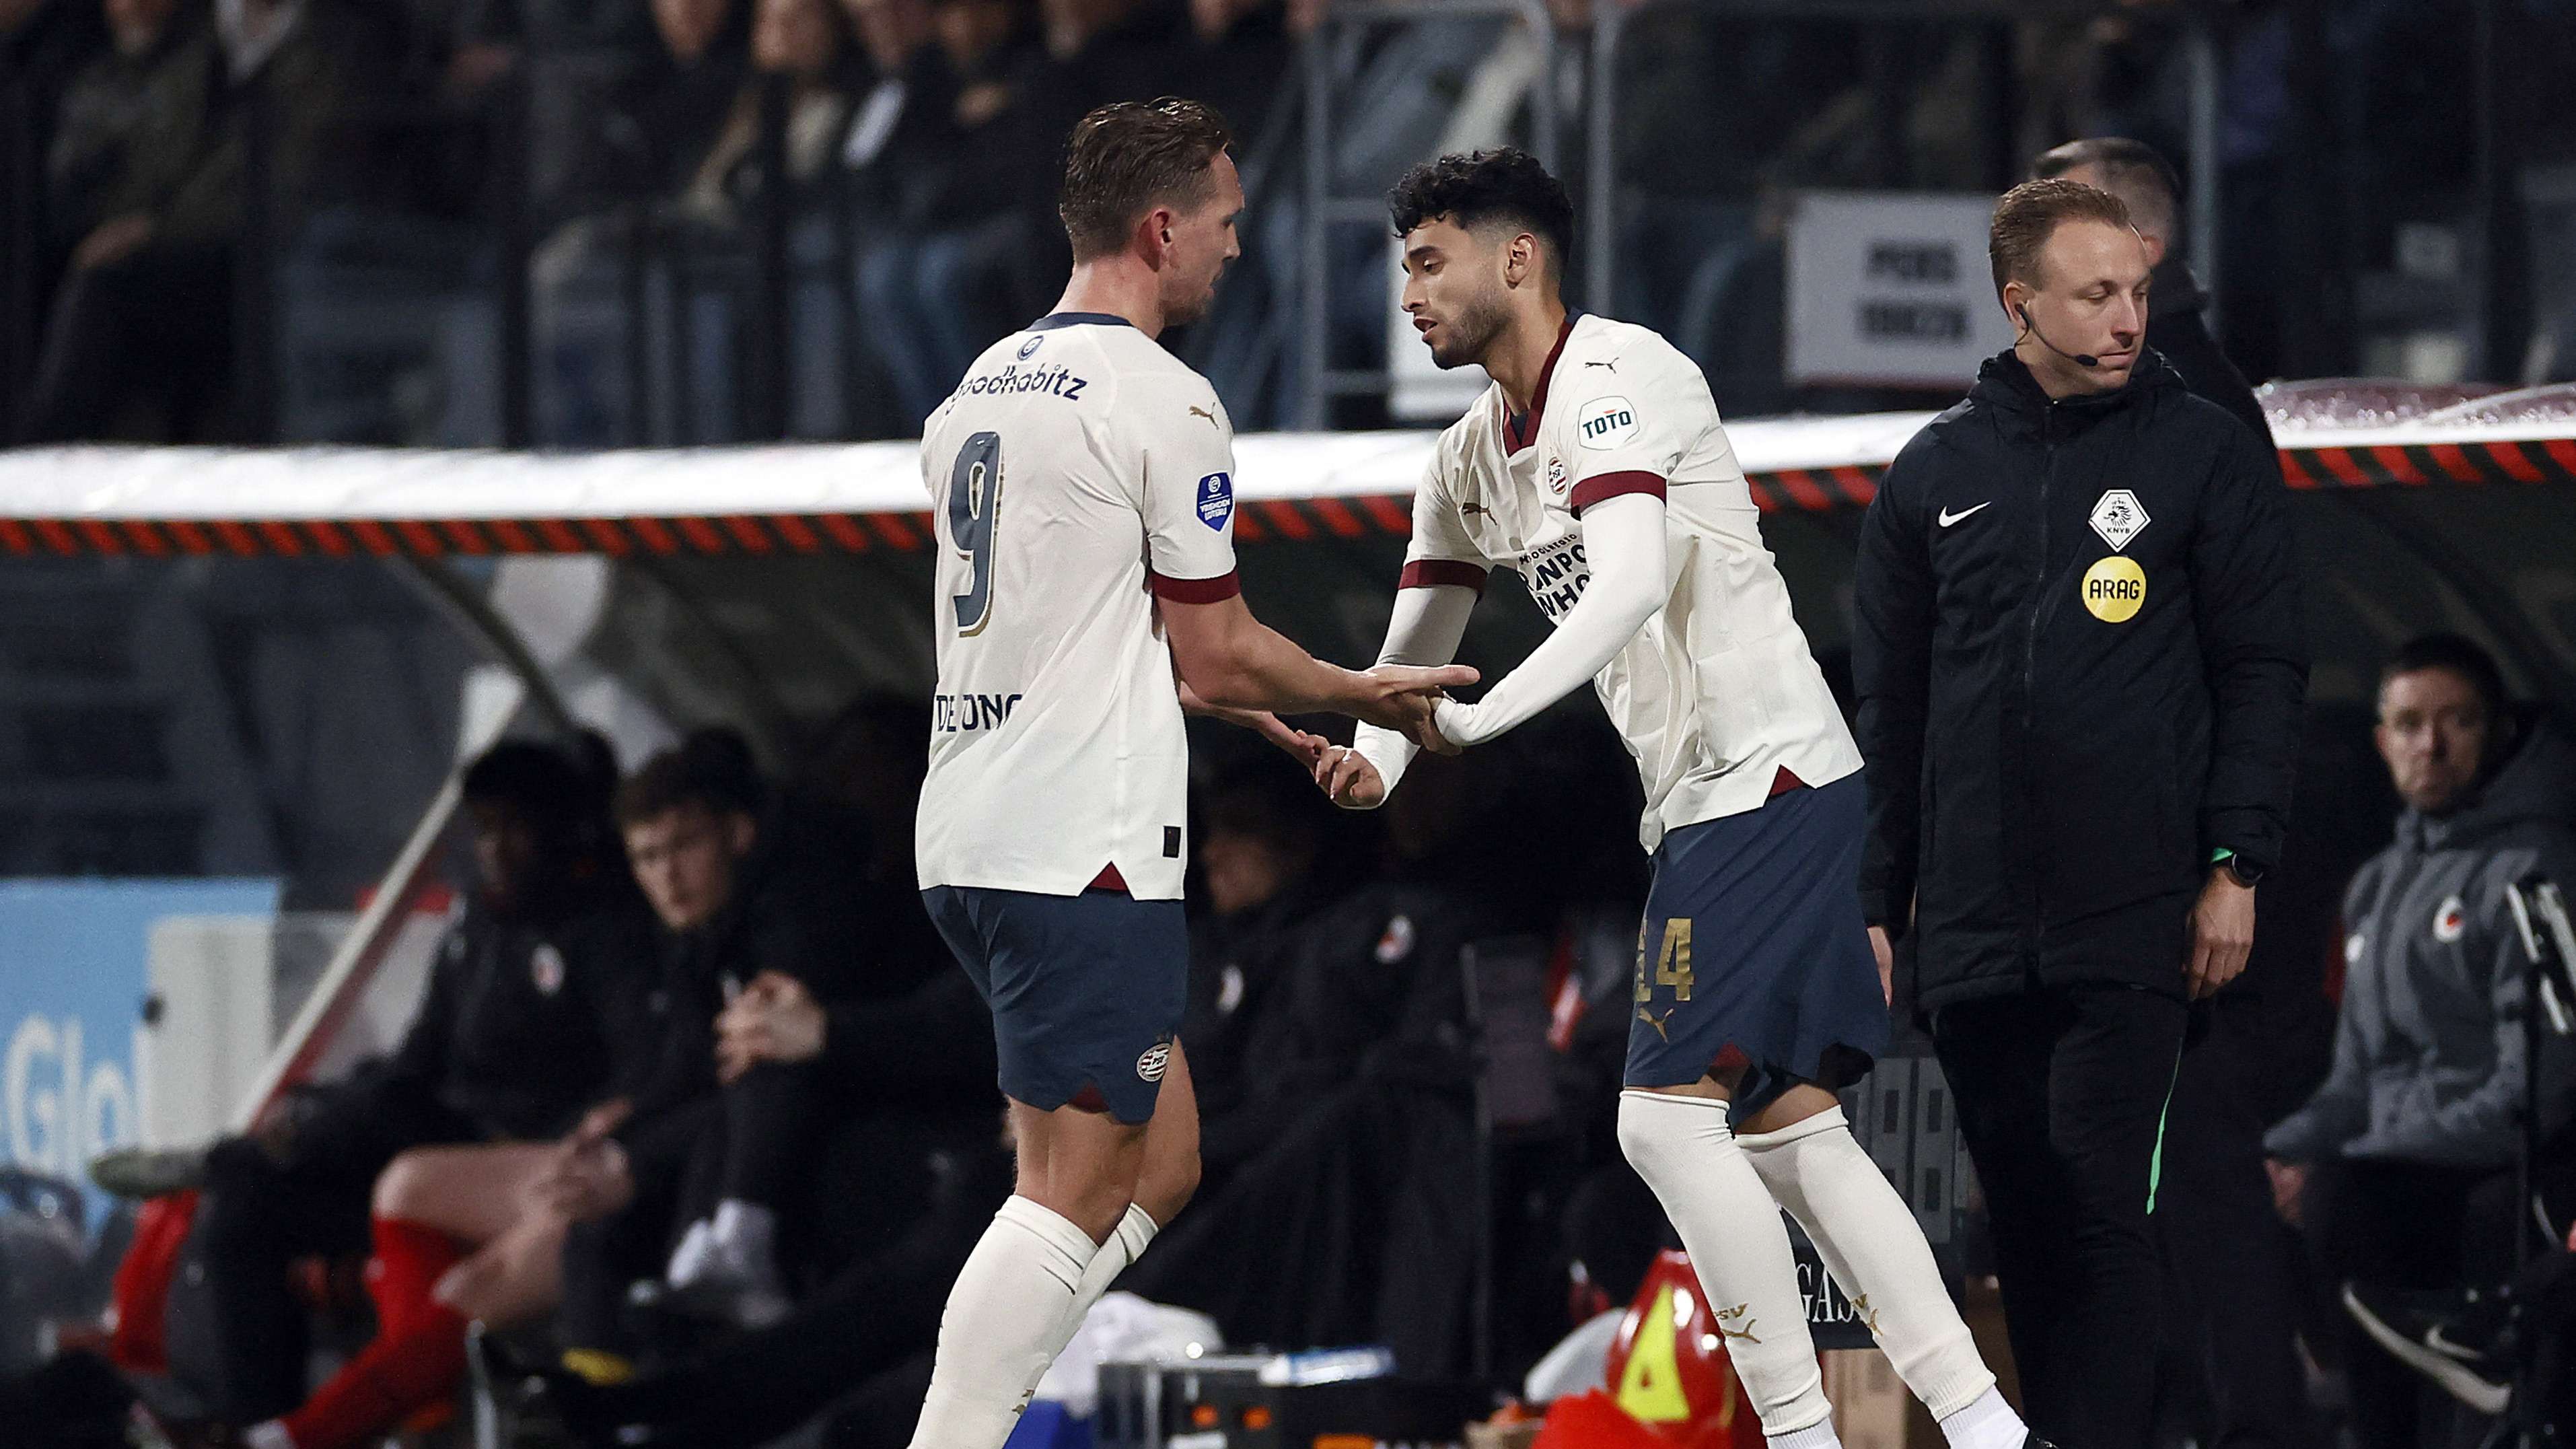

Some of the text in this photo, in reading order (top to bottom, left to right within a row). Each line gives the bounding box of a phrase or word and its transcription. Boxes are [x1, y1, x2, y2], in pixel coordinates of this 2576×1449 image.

[1582, 410, 1632, 439] TOTO
[948, 431, 1005, 637] 9
[2089, 579, 2141, 600] ARAG
[935, 694, 957, 732] DE
